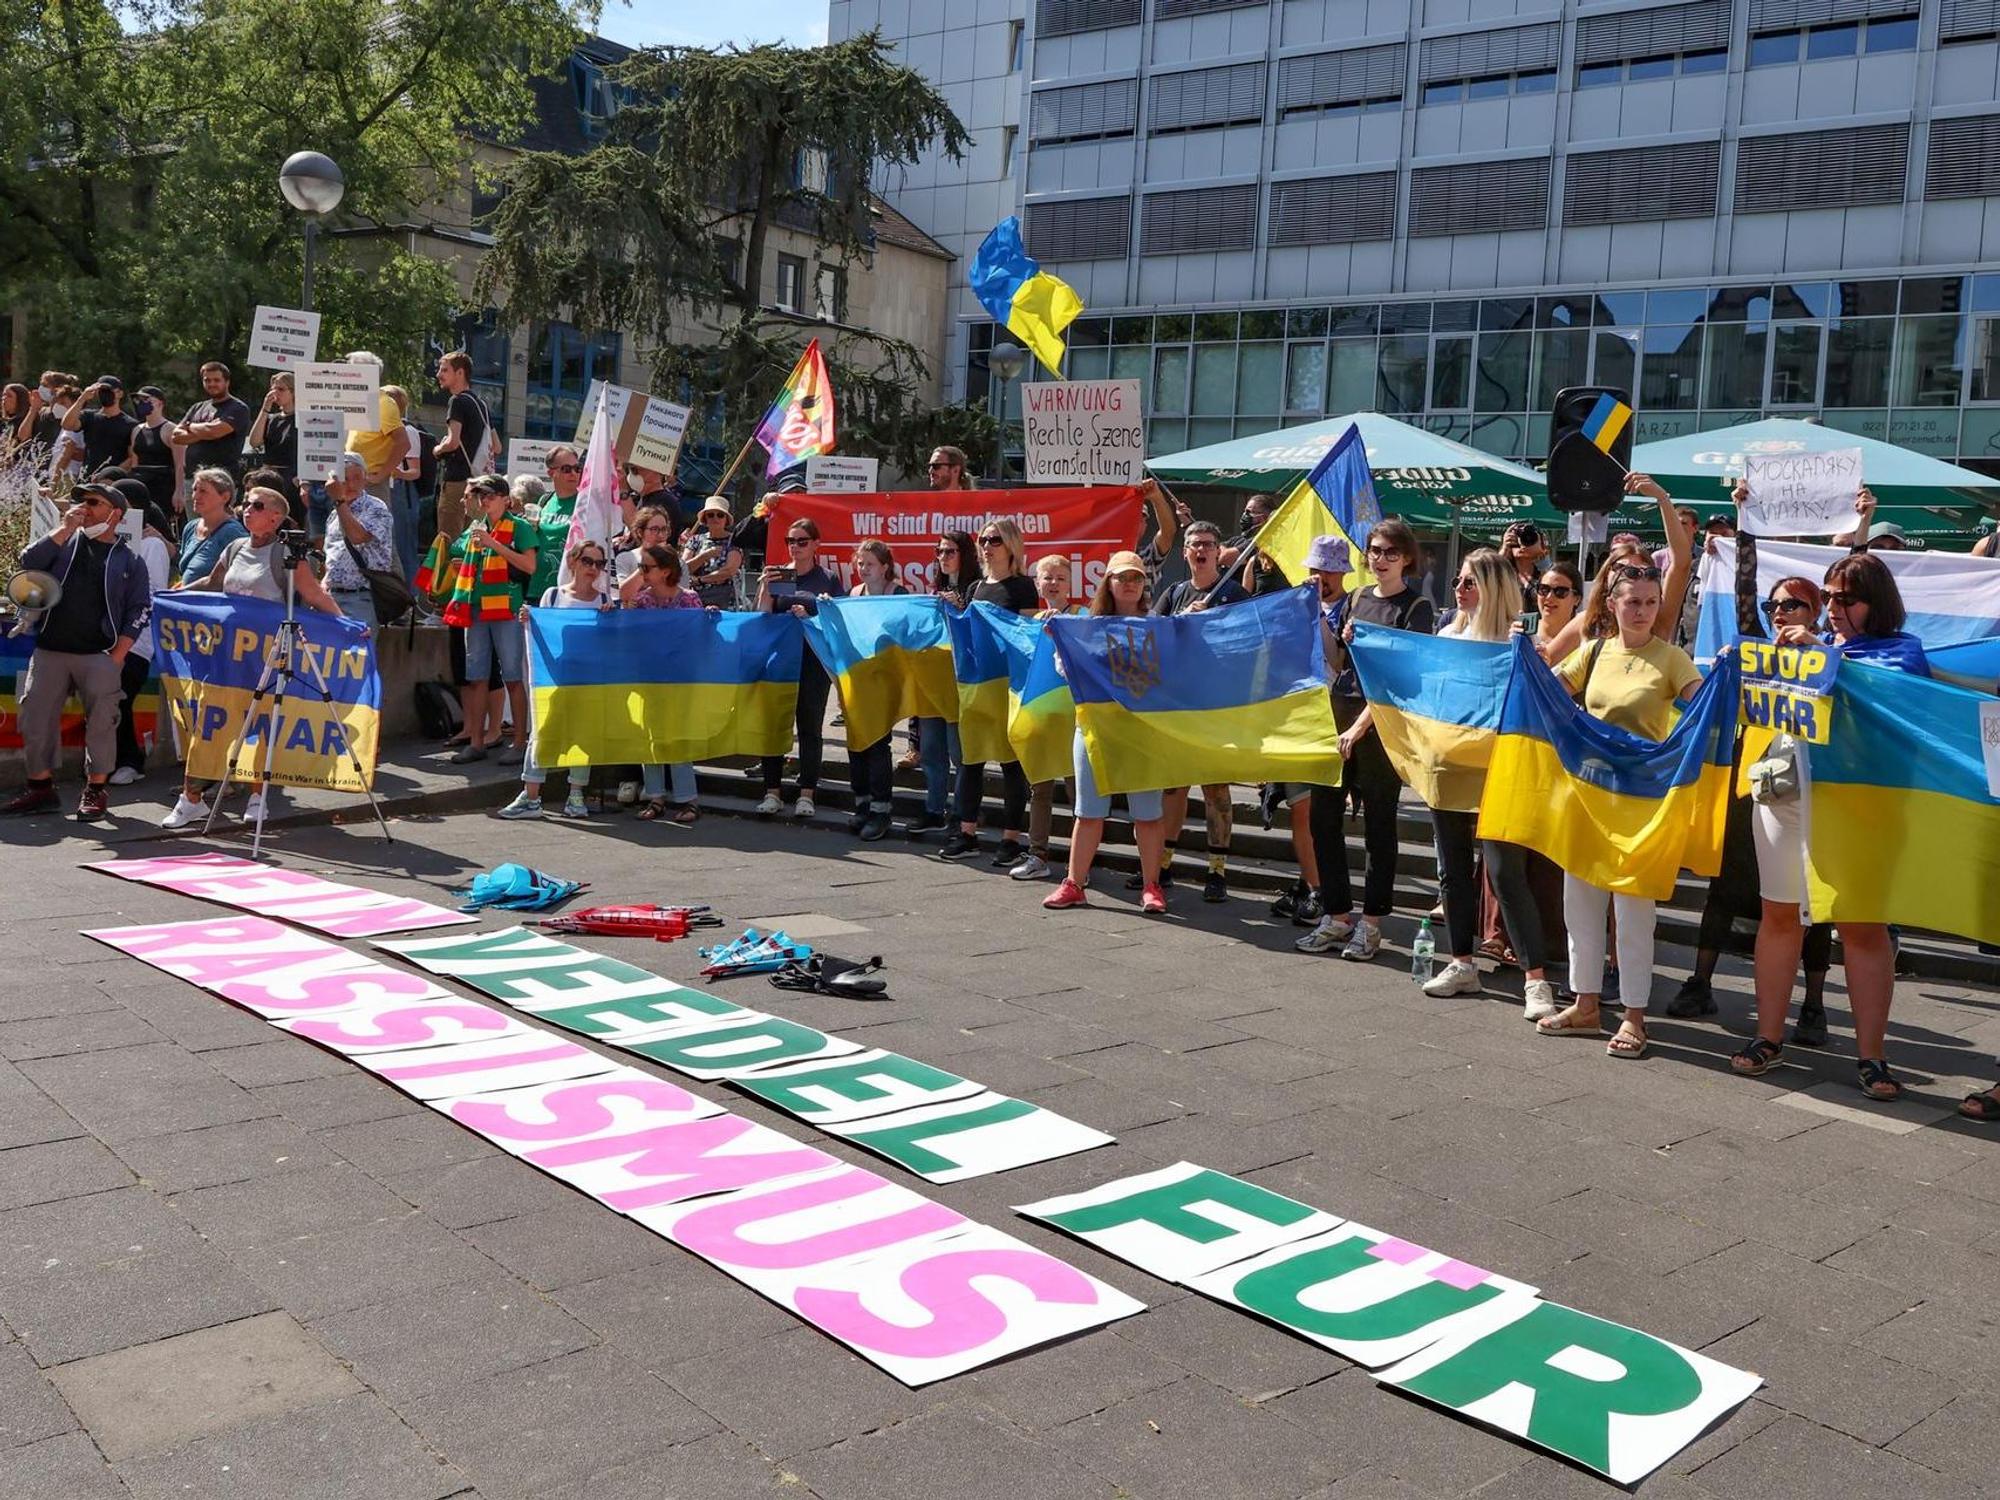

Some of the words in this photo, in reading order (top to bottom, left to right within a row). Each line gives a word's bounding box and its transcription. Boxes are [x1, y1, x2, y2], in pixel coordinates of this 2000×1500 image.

[1028, 413, 1084, 446] Rechte
[1091, 413, 1142, 448] Szene
[636, 445, 671, 463] Путина!
[1027, 448, 1131, 485] Veranstaltung
[1782, 483, 1807, 498] НА
[852, 513, 884, 535] Wir
[887, 513, 926, 535] sind
[159, 617, 224, 656] STOP
[1740, 641, 1827, 682] STOP
[243, 709, 352, 757] WAR
[1743, 688, 1817, 740] WAR
[97, 852, 470, 938] KEIN
[97, 917, 1098, 1358] RASSISMUS
[400, 929, 1035, 1173] VEEDEL
[1042, 1170, 1702, 1474] FÜR
